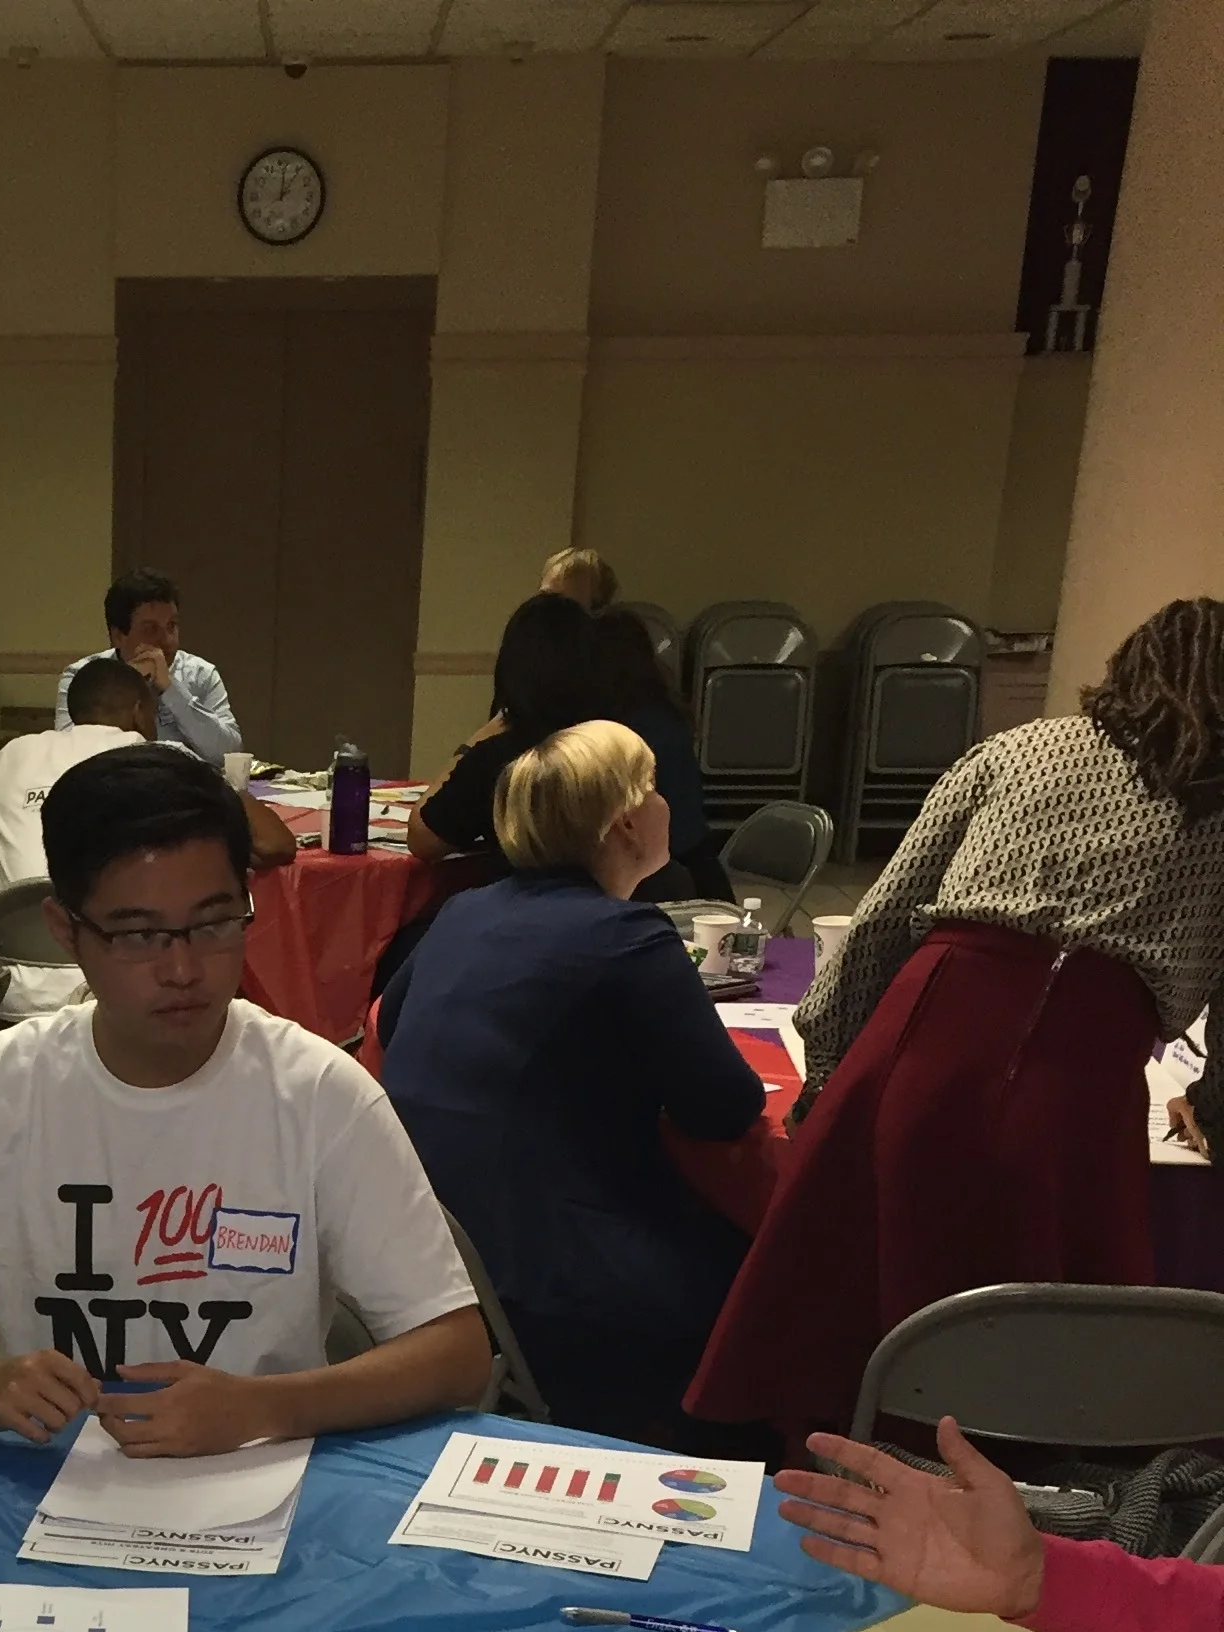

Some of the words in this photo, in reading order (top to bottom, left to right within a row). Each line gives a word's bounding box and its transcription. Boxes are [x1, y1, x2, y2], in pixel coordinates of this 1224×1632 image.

[56, 1184, 114, 1291] I
[216, 1226, 290, 1255] BRENDAN
[35, 1296, 253, 1382] NY
[137, 1529, 250, 1544] PASSNYC
[603, 1517, 719, 1541] PASSNYC
[129, 1555, 244, 1570] PASSNYC
[499, 1542, 615, 1570] PASSNYC
